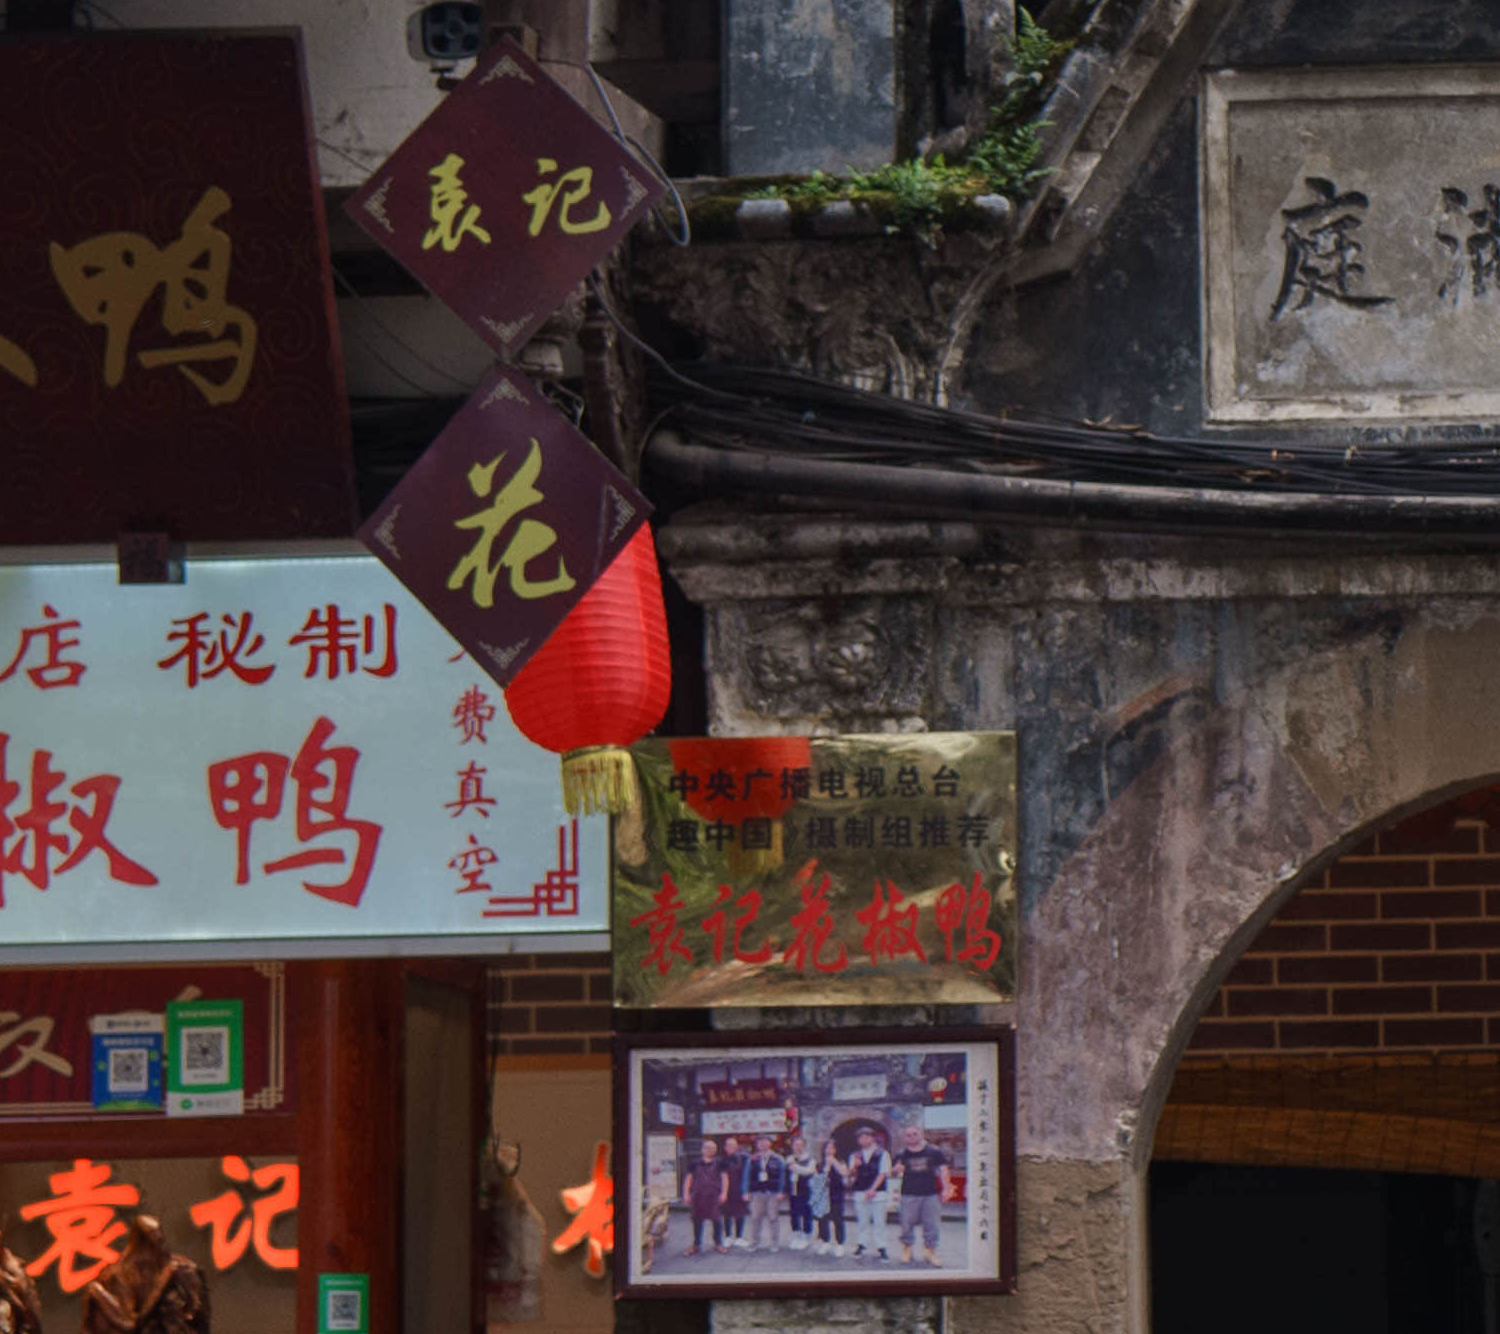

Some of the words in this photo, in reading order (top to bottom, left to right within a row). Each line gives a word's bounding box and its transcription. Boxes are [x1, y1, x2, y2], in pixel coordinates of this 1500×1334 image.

[421, 153, 611, 252] 袁记
[446, 437, 576, 609] 花
[444, 629, 498, 895] 费真空
[668, 764, 961, 803] 中央广播电视总台
[629, 869, 1001, 976] 袁记花椒鸭
